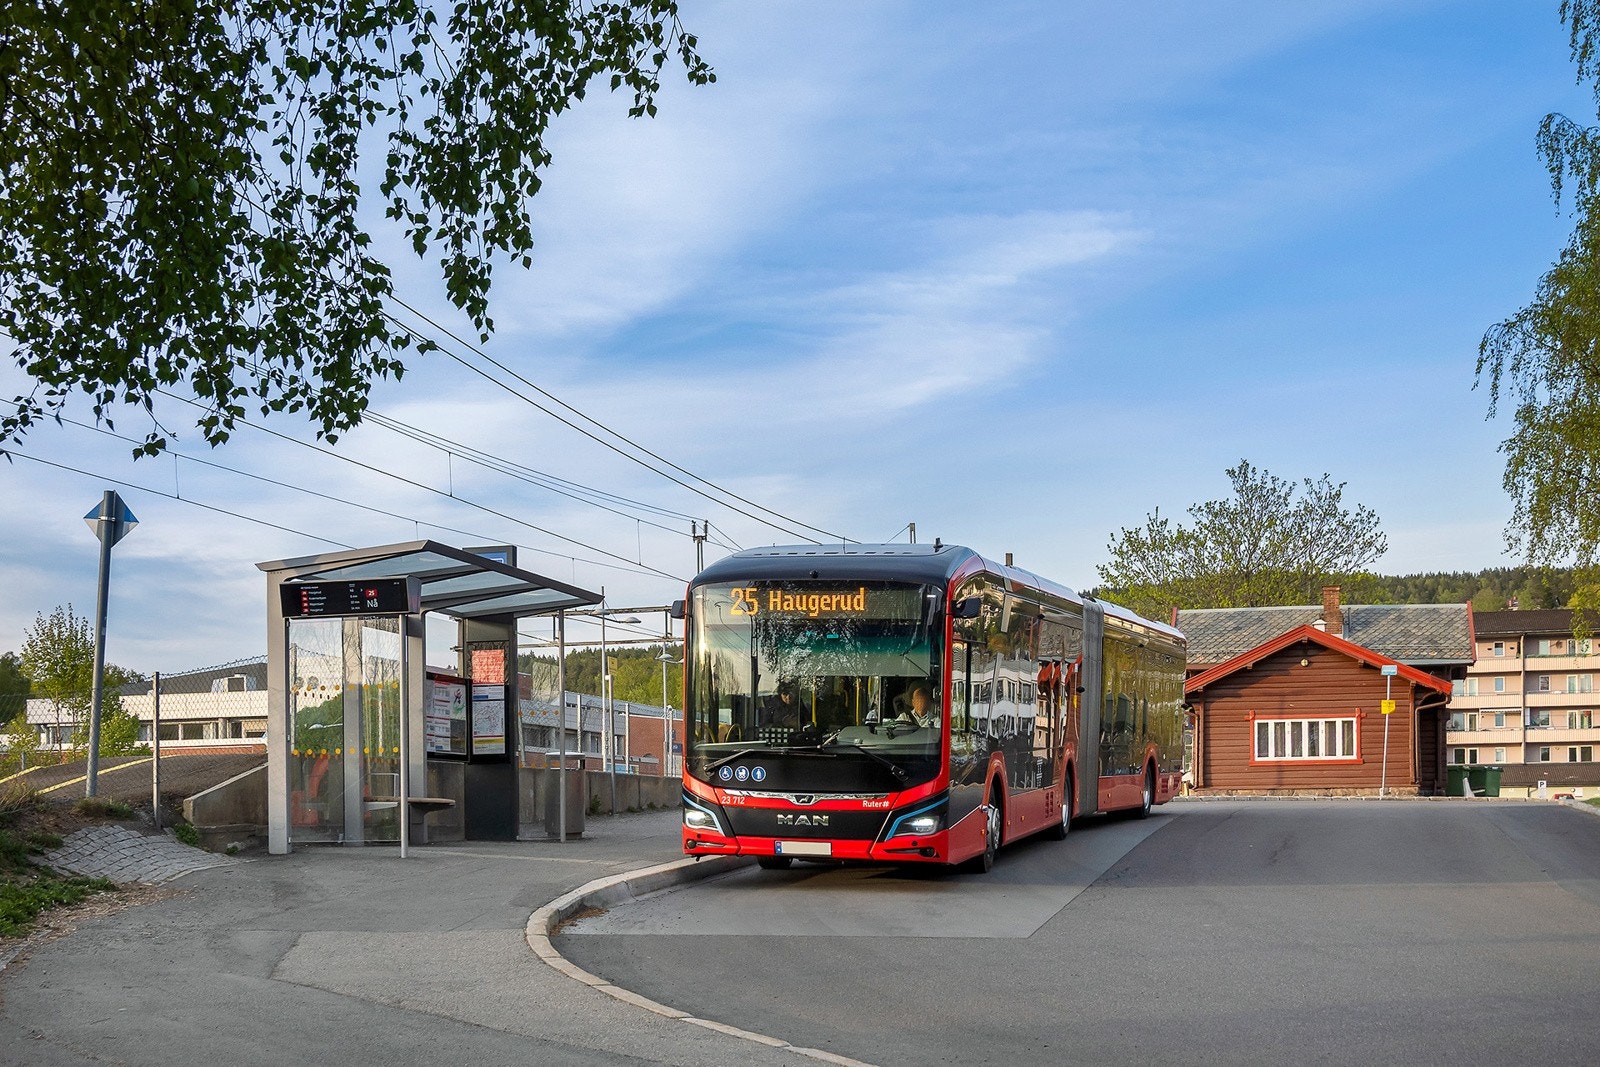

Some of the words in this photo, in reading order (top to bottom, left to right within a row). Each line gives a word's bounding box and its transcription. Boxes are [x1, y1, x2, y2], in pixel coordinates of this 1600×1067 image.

[367, 598, 378, 608] Nå
[730, 587, 759, 616] 25
[769, 587, 866, 617] Haugerud
[721, 796, 731, 805] 23
[733, 796, 745, 805] 712
[777, 814, 829, 826] MAN
